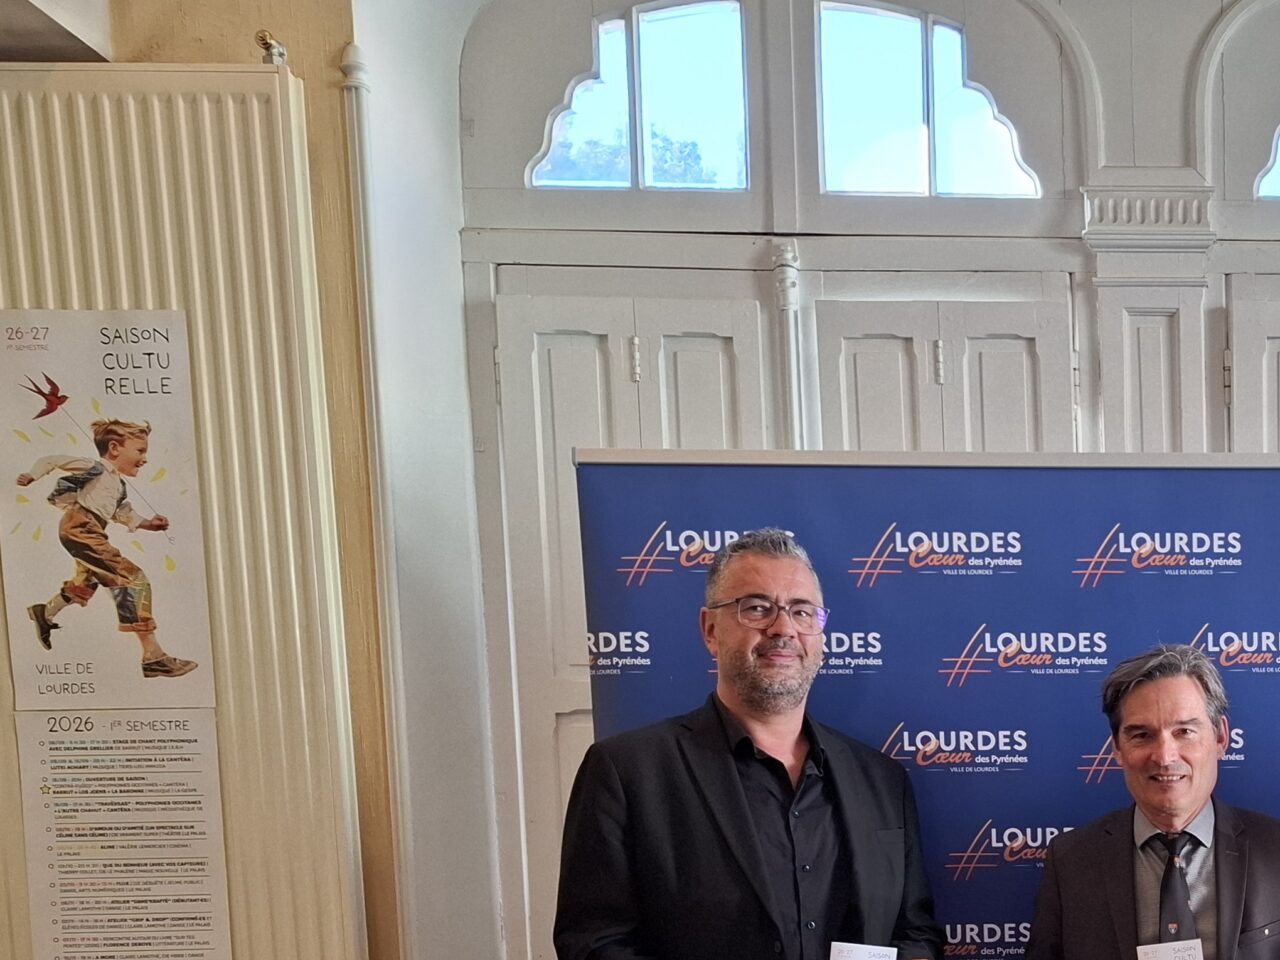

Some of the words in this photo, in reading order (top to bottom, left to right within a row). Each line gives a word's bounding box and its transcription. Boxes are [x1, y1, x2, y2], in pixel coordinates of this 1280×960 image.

[5, 327, 49, 340] 26-27
[100, 327, 170, 345] SAISON
[102, 353, 170, 370] CULTU
[105, 377, 172, 394] RELLE
[895, 532, 1022, 553] LOURDES
[1118, 532, 1241, 553] LOURDES
[968, 557, 983, 566] des
[985, 557, 1022, 568] Pyrénées
[1189, 557, 1204, 566] des
[1205, 557, 1242, 568] Pyrénées
[985, 632, 1107, 653] LOURDES
[36, 663, 71, 675] VILLE
[76, 662, 94, 675] DE
[1055, 656, 1070, 665] des
[1071, 656, 1108, 667] Pyrénées
[38, 682, 95, 695] LOURDES
[47, 716, 94, 732] 2026
[126, 720, 190, 732] SEMESTRE
[903, 730, 1027, 751] LOURDES
[975, 755, 990, 763] des
[991, 754, 1028, 765] Pyrénées
